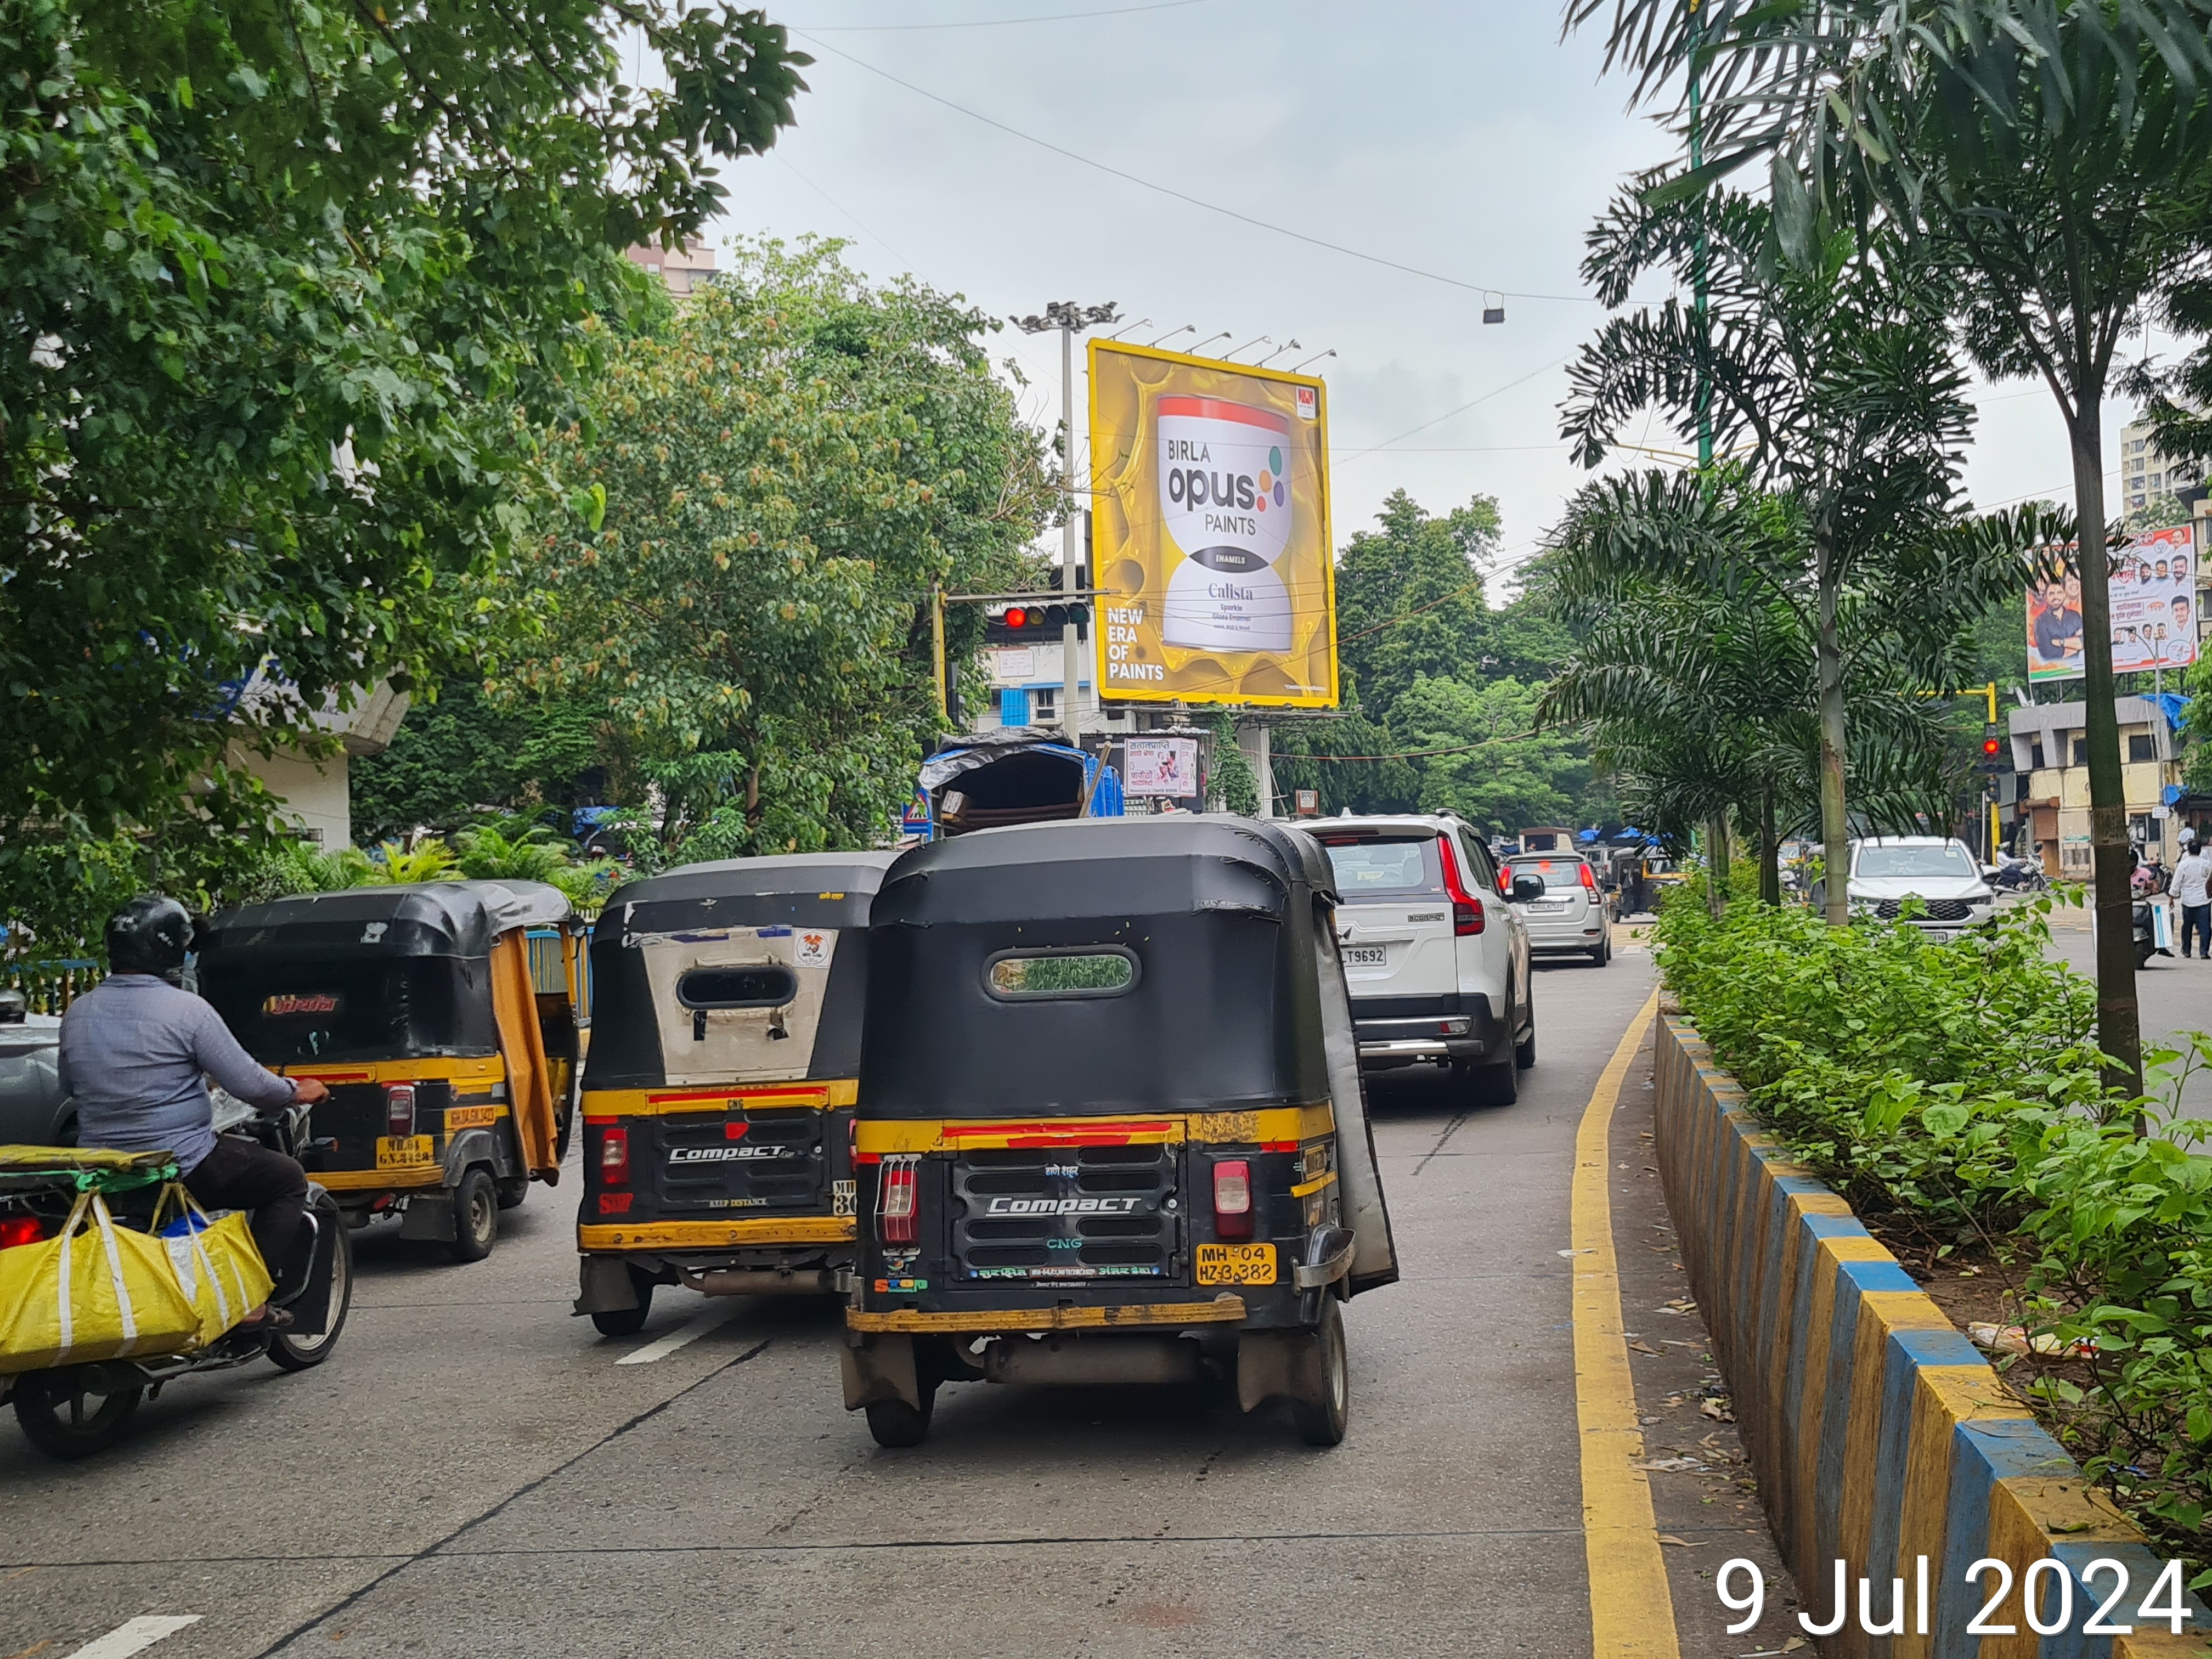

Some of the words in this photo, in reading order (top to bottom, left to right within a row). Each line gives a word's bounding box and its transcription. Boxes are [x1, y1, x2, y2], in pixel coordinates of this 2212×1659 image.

[1169, 440, 1211, 463] BIRLA
[1169, 468, 1255, 511] opus
[1205, 514, 1256, 536] PAINTS
[1215, 554, 1245, 565] ENAMELS
[1209, 583, 1254, 601] Calista
[1108, 607, 1143, 625] NEW
[1109, 625, 1138, 643] ERA
[1109, 644, 1129, 661] OF
[1109, 662, 1164, 681] PAINTS
[727, 1099, 743, 1110] CNG
[668, 1146, 786, 1164] Compact
[709, 1199, 730, 1207] KEEP
[730, 1198, 767, 1207] DISTANCE
[985, 1197, 1142, 1217] Compact
[1046, 1238, 1083, 1249] CNG
